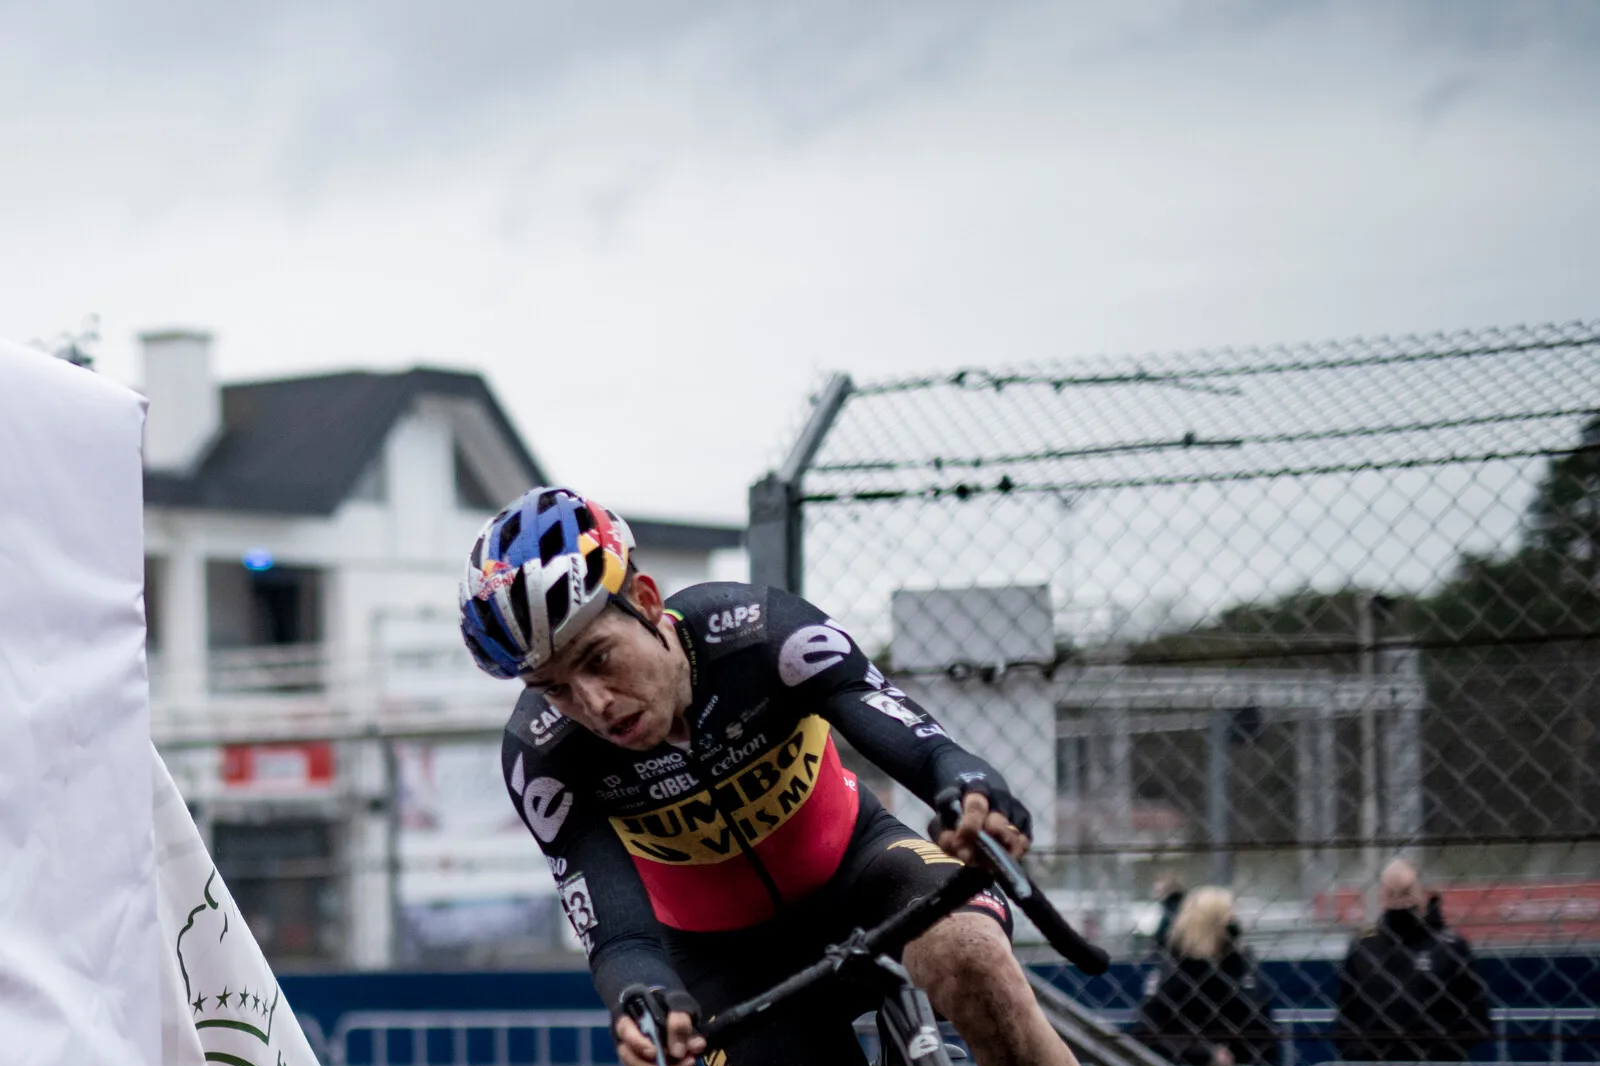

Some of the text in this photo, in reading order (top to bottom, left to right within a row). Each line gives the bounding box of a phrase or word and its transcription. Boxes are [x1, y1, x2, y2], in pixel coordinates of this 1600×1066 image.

[708, 603, 761, 633] CAPS
[529, 705, 563, 737] CA
[633, 752, 683, 774] DOMO
[622, 731, 805, 838] JUMBO
[649, 772, 700, 800] CIBEL
[700, 752, 819, 856] VISMA
